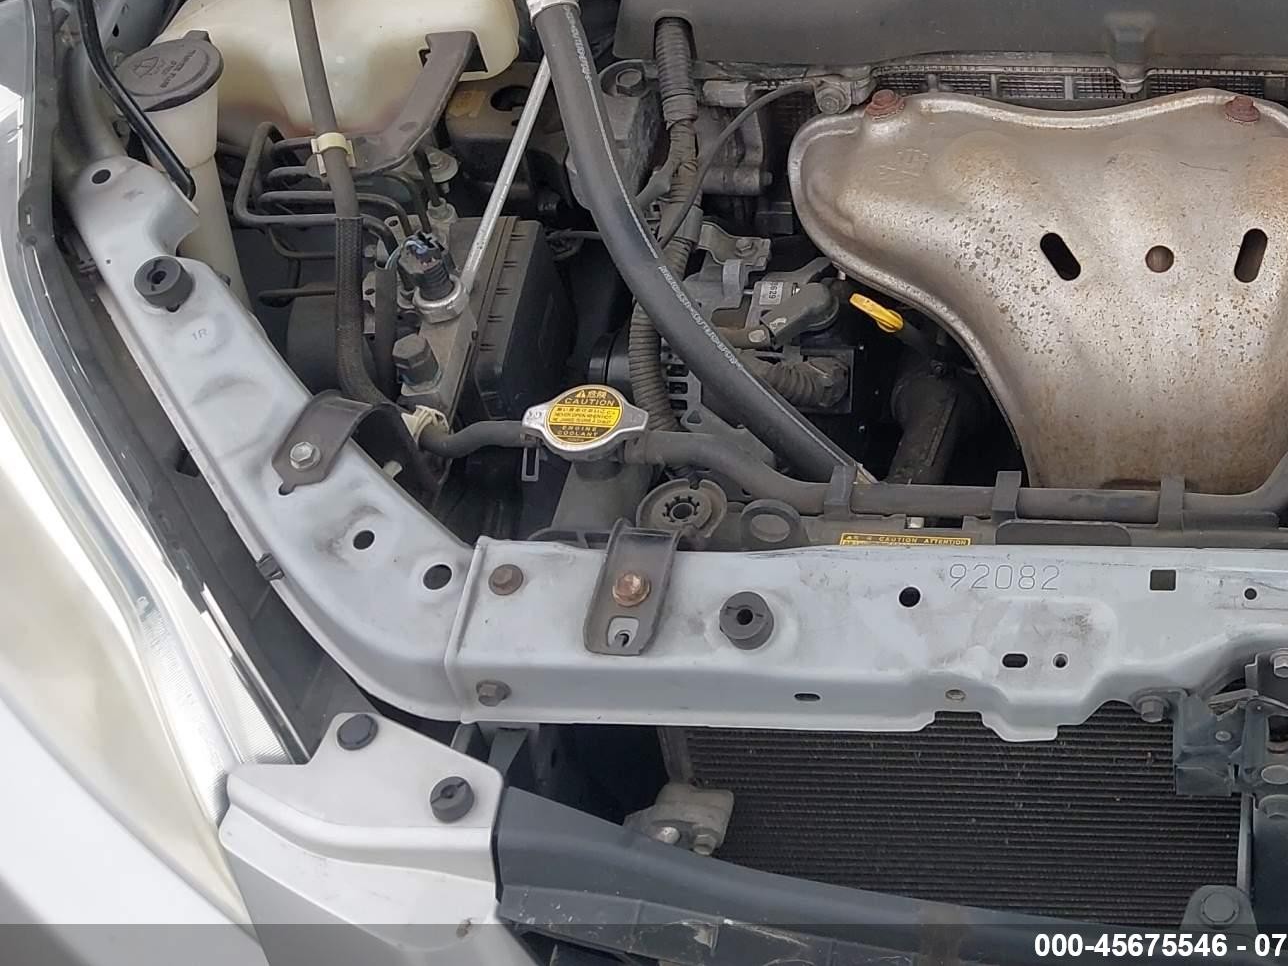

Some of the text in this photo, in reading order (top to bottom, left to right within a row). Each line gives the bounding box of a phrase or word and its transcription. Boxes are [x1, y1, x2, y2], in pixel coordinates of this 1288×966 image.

[564, 398, 615, 406] CAUTION
[878, 536, 918, 544] CAUTION
[923, 538, 968, 546] ATTENTION
[949, 563, 1060, 590] 92082
